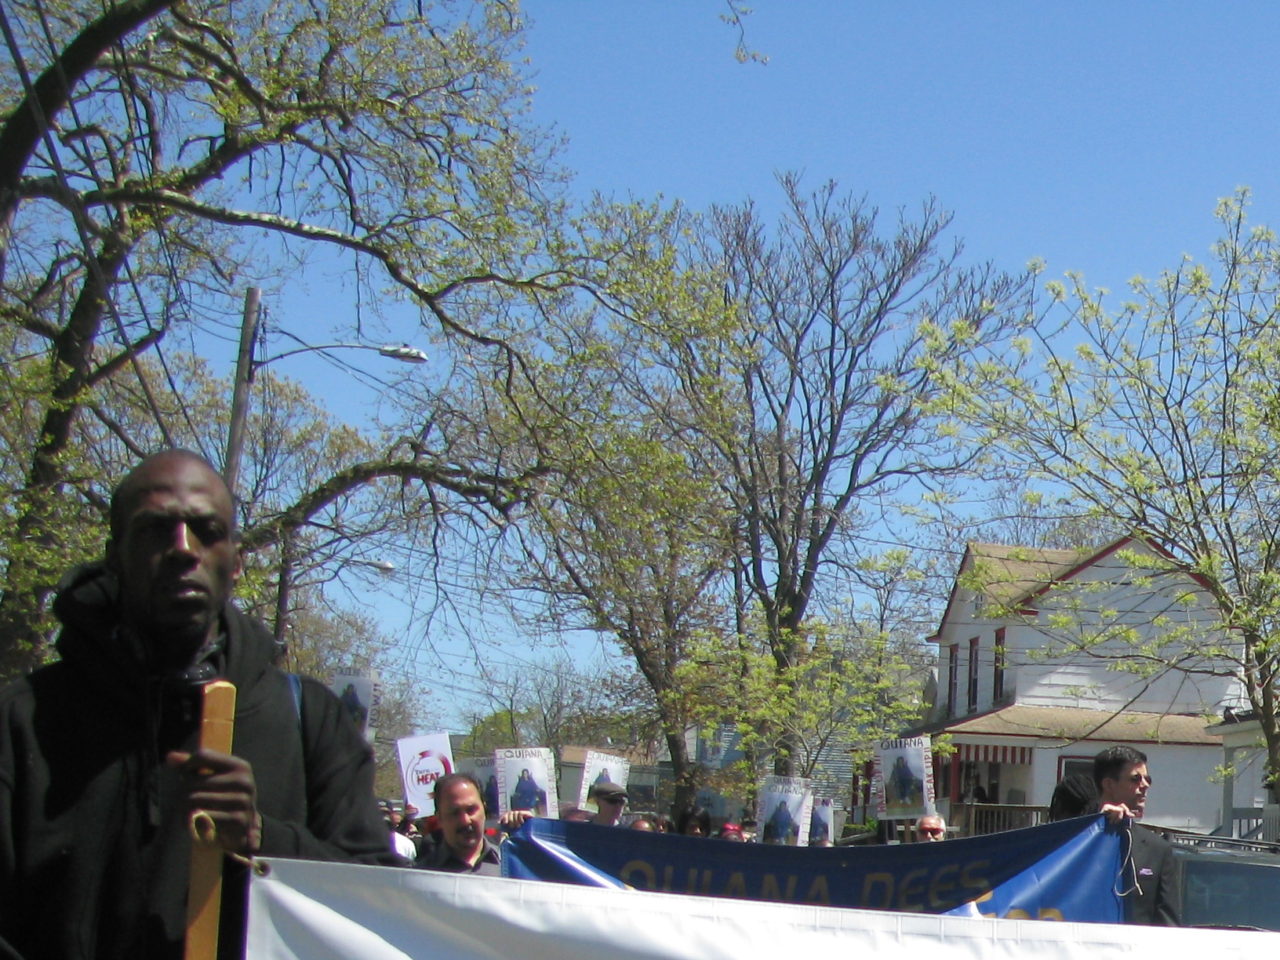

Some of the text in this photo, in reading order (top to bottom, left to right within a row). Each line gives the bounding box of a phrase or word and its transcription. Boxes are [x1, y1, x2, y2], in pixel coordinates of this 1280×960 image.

[881, 737, 924, 750] QUIANA
[504, 749, 543, 759] QUIANA
[416, 772, 440, 786] HEAT
